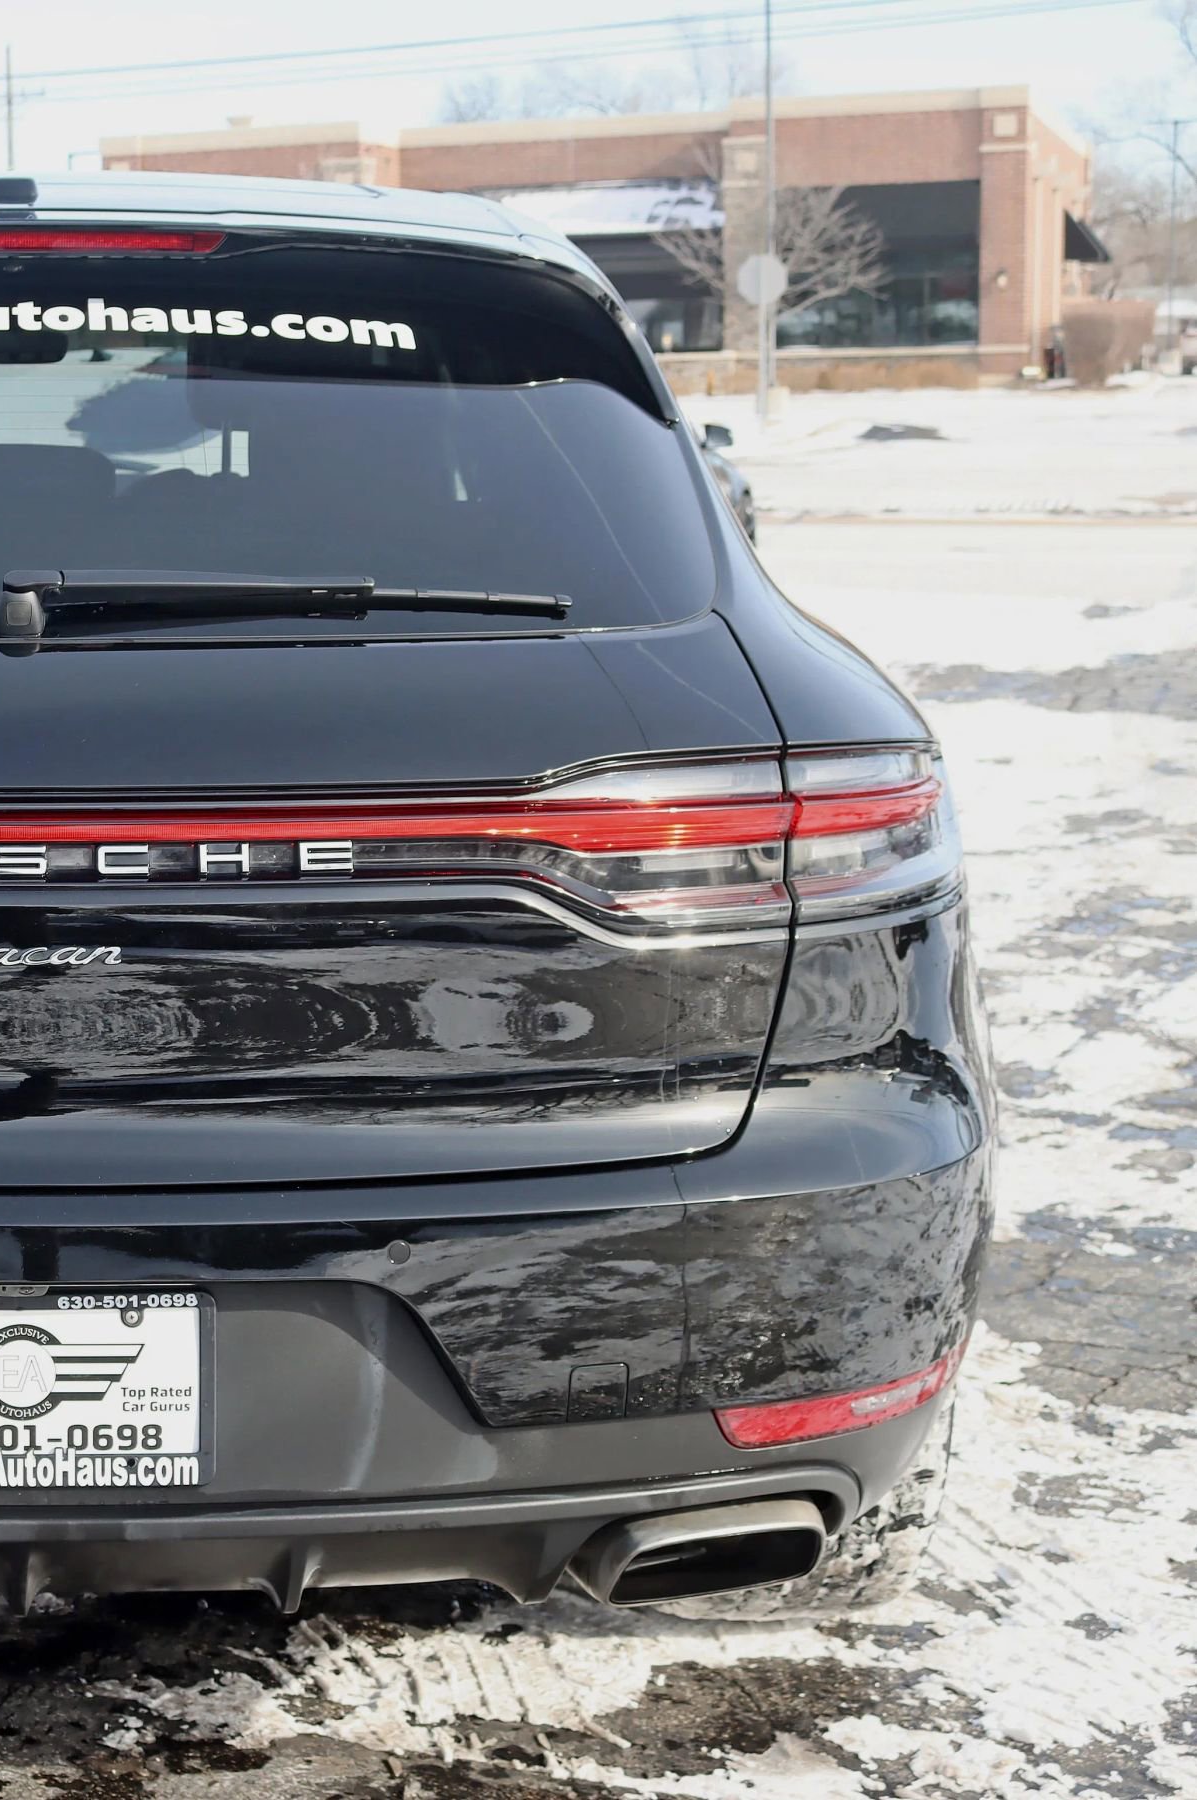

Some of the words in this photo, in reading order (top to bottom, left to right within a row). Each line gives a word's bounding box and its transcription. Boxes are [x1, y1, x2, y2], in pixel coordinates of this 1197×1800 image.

[57, 1294, 199, 1311] 630-501-0698
[121, 1386, 146, 1400] Top
[150, 1386, 192, 1398] Rated
[122, 1401, 146, 1412] Car
[149, 1401, 191, 1412] Gurus
